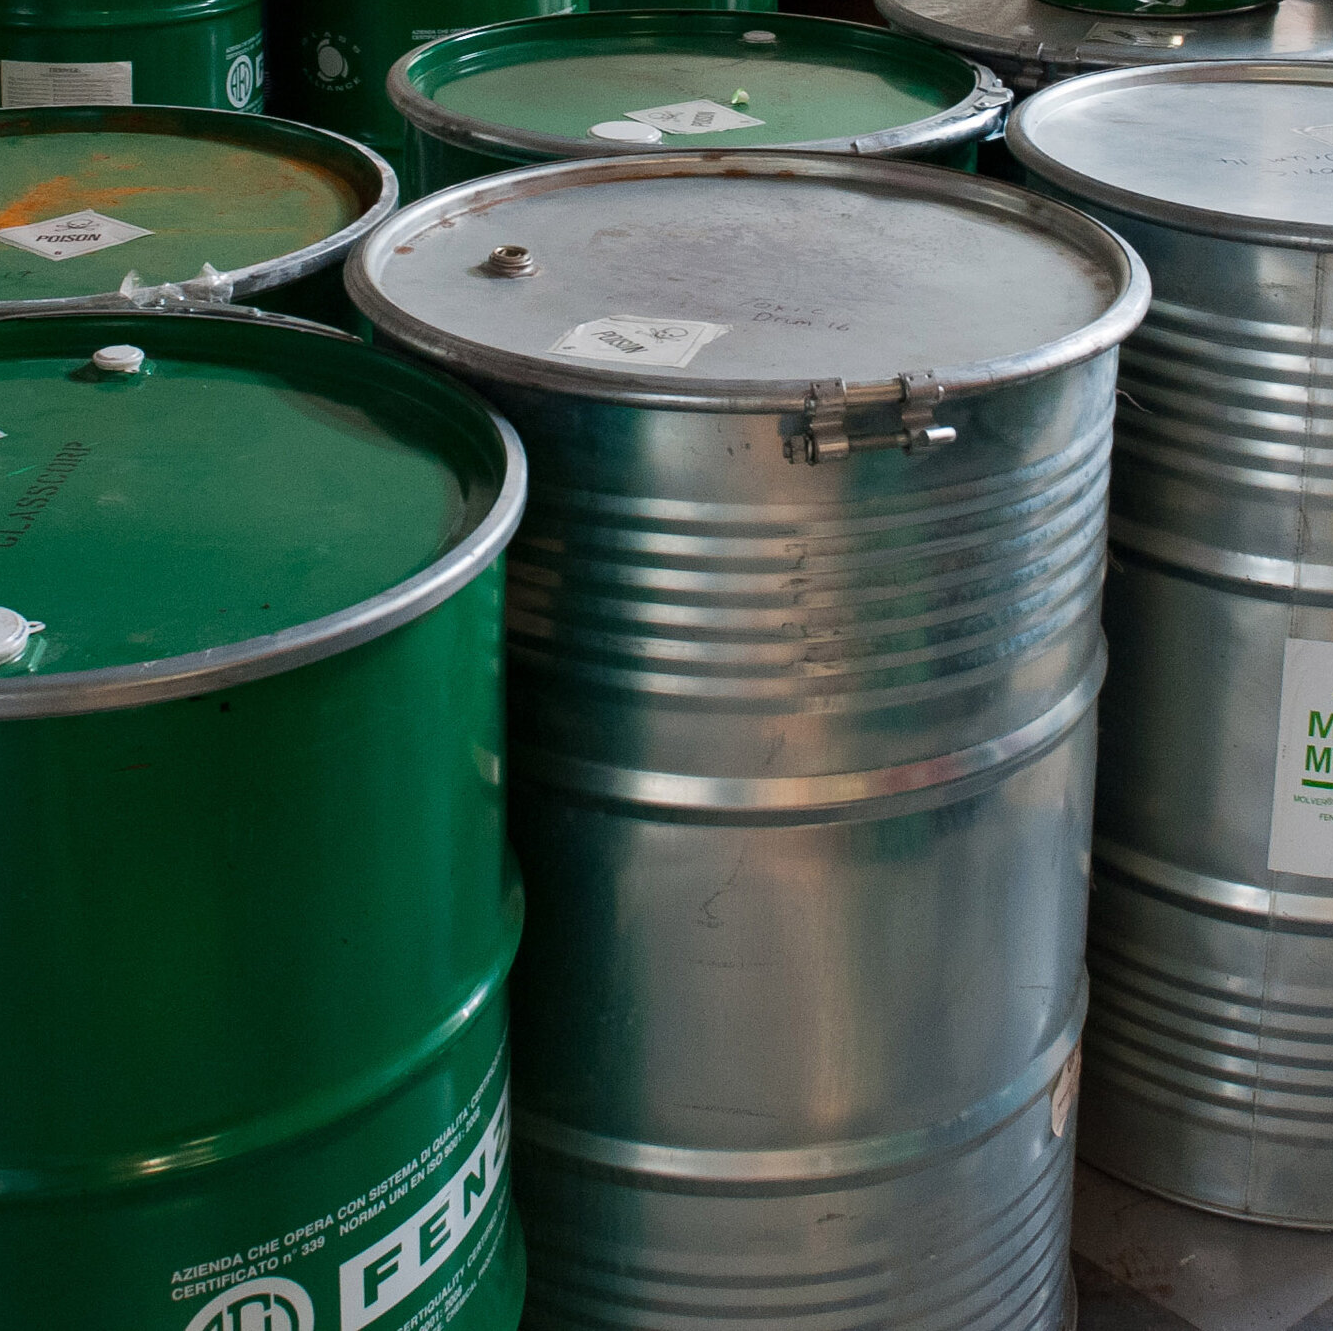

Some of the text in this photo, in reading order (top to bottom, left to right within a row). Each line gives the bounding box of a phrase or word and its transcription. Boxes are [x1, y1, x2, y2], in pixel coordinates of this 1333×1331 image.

[35, 233, 102, 244] POISON
[590, 330, 649, 354] POISON
[171, 1252, 244, 1284] AZIENDA
[247, 1238, 280, 1261] CHE
[283, 1213, 335, 1246] OPERA
[336, 1194, 366, 1220] CON
[368, 1158, 419, 1202] SISTEMA
[420, 1146, 431, 1164] DI
[339, 1199, 387, 1237] NORMA
[388, 1182, 409, 1205] UNI
[410, 1171, 425, 1190] EN
[426, 1153, 443, 1175] ISO
[349, 1082, 510, 1322] FENZ
[170, 1256, 279, 1301] CERTIFICATO
[301, 1235, 326, 1257] 339
